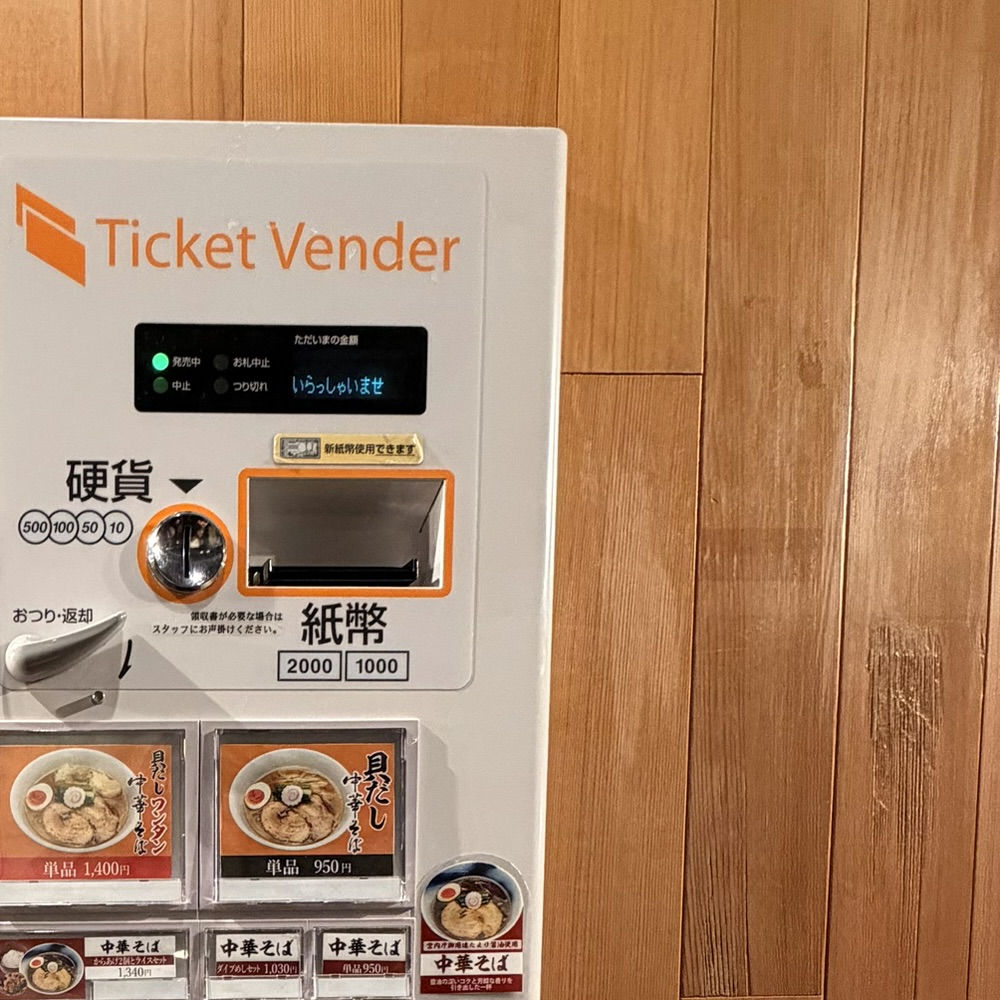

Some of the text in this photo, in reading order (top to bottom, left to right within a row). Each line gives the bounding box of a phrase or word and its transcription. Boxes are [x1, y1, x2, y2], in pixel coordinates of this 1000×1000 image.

[95, 217, 461, 273] Ticket Vender
[294, 334, 359, 346] ただいまの金額
[172, 356, 201, 368] 発売中
[232, 356, 271, 368] お札中止
[172, 380, 191, 392] 中止
[232, 381, 268, 392] つり切れ
[292, 375, 385, 397] いらっしゃいませ
[323, 443, 416, 457] 新紙幣使用できます
[65, 459, 154, 504] 硬貨
[22, 519, 126, 536] 500 100 50 10
[12, 608, 94, 624] おつり・返却
[190, 612, 285, 622] 領収書が必要な場合は
[301, 602, 388, 647] 紙幣
[286, 658, 333, 675] 2000
[355, 658, 399, 675] 1000
[364, 751, 393, 830] 貝だし
[127, 774, 148, 855] 中華そば
[342, 772, 364, 854] 中華そば
[43, 861, 130, 878] 単品 1,400円
[266, 858, 300, 876] 単品
[99, 939, 161, 955] 中華そば
[219, 938, 295, 958] 中華そば
[328, 937, 402, 957] 中華そば
[117, 967, 152, 978] 1,340円
[263, 963, 298, 974] 1,030円
[434, 954, 509, 974] 中華そば
